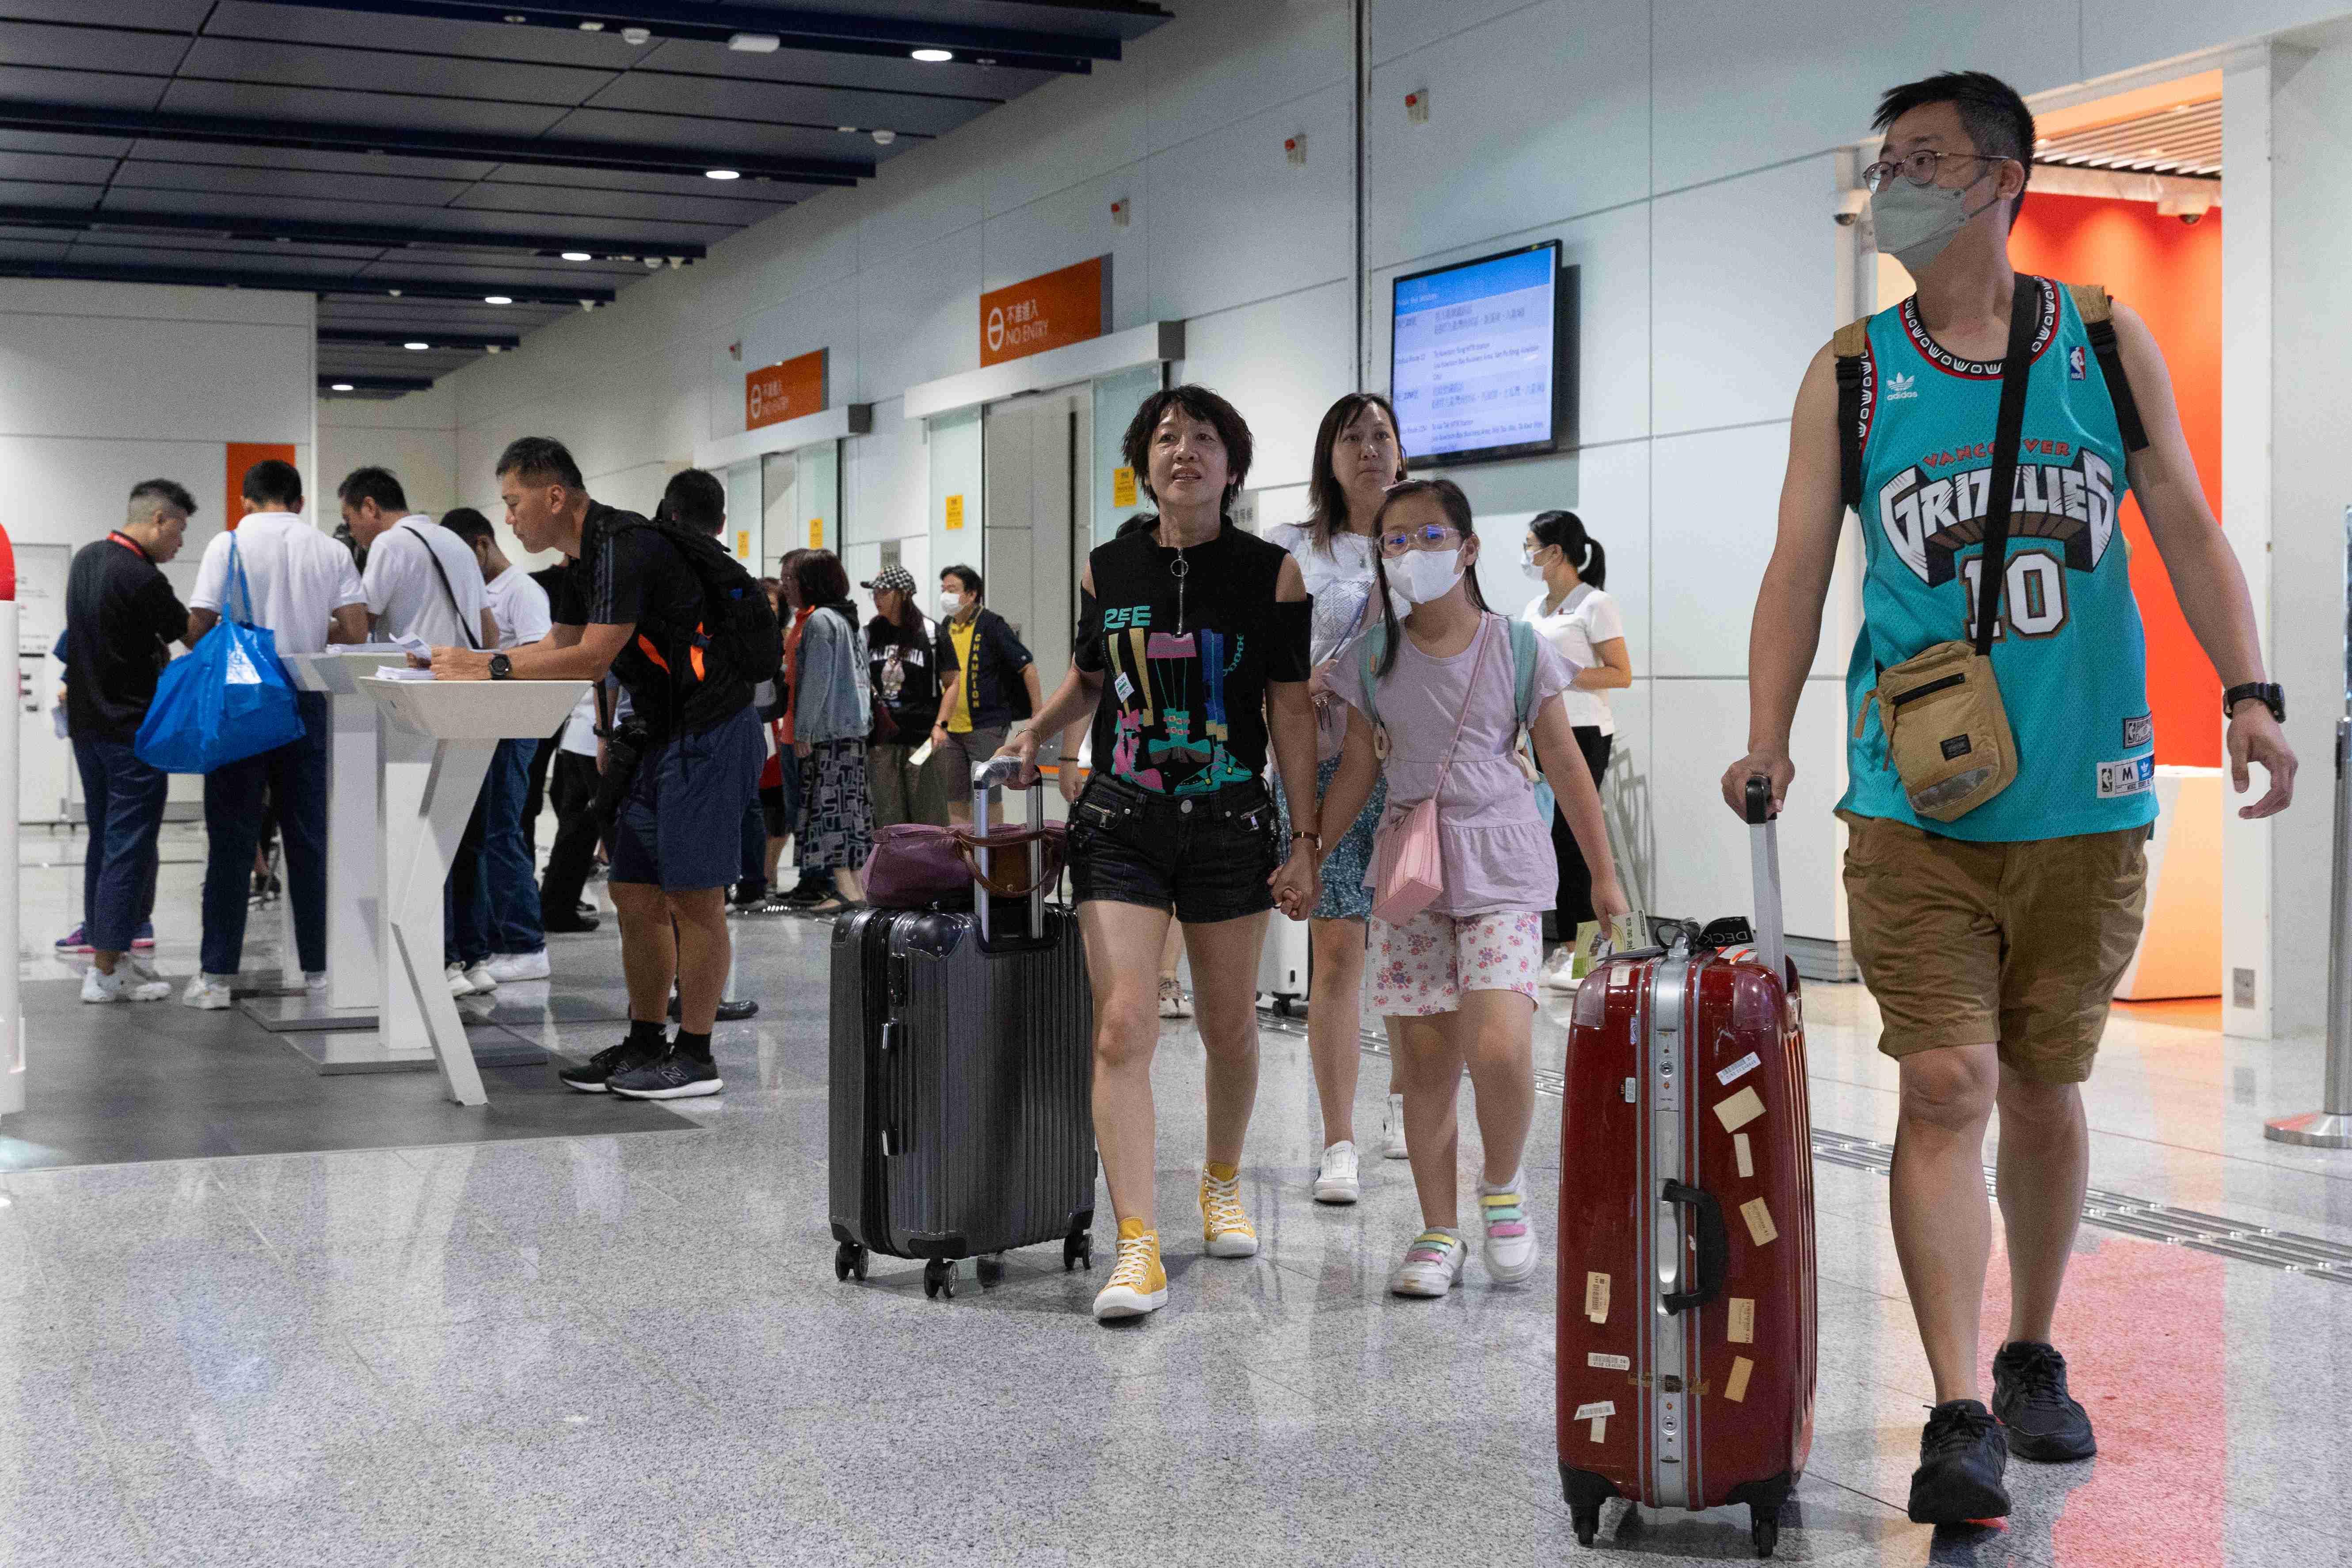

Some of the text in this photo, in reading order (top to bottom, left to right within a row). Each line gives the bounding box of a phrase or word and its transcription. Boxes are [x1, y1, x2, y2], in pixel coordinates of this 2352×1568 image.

[1887, 391, 1918, 401] adidas
[972, 633, 982, 708] CHAMPION
[2123, 767, 2133, 781] M
[1703, 931, 1748, 944] DECK
